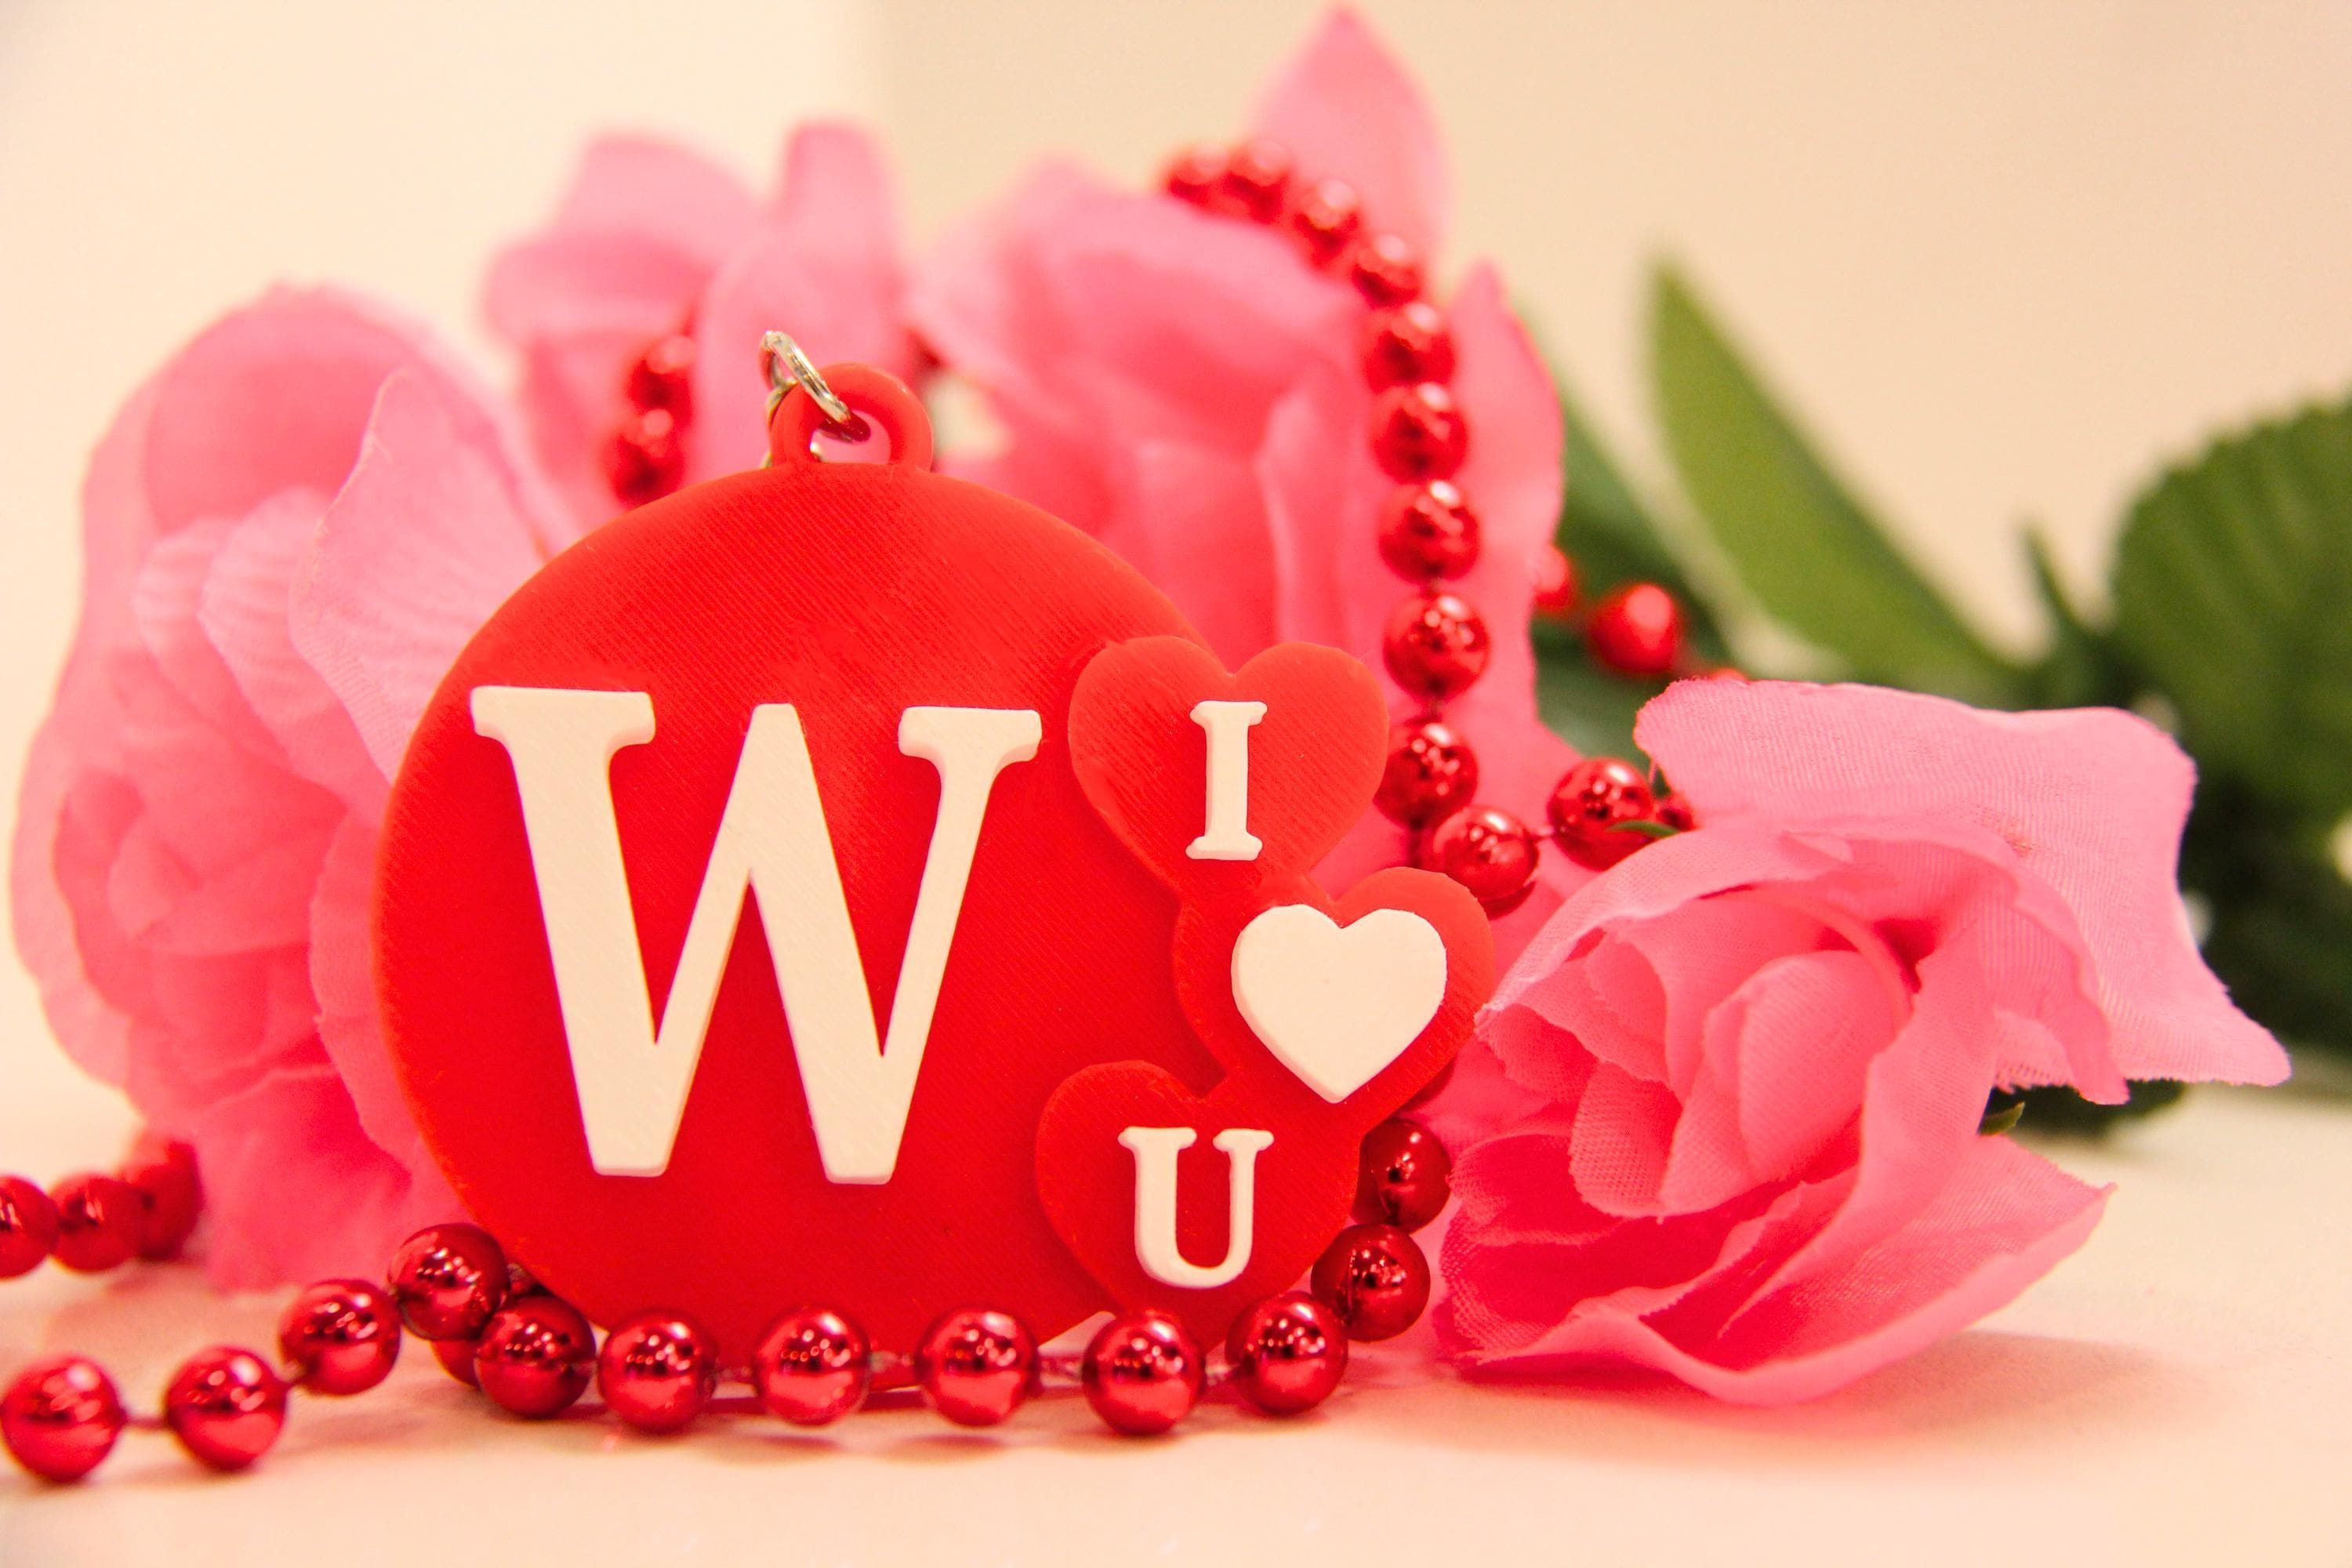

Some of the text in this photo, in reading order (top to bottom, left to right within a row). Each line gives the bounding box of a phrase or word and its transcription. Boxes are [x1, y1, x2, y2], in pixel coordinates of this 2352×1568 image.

[1185, 700, 1268, 861] I
[470, 685, 1043, 1184] W
[1119, 1126, 1274, 1288] U
